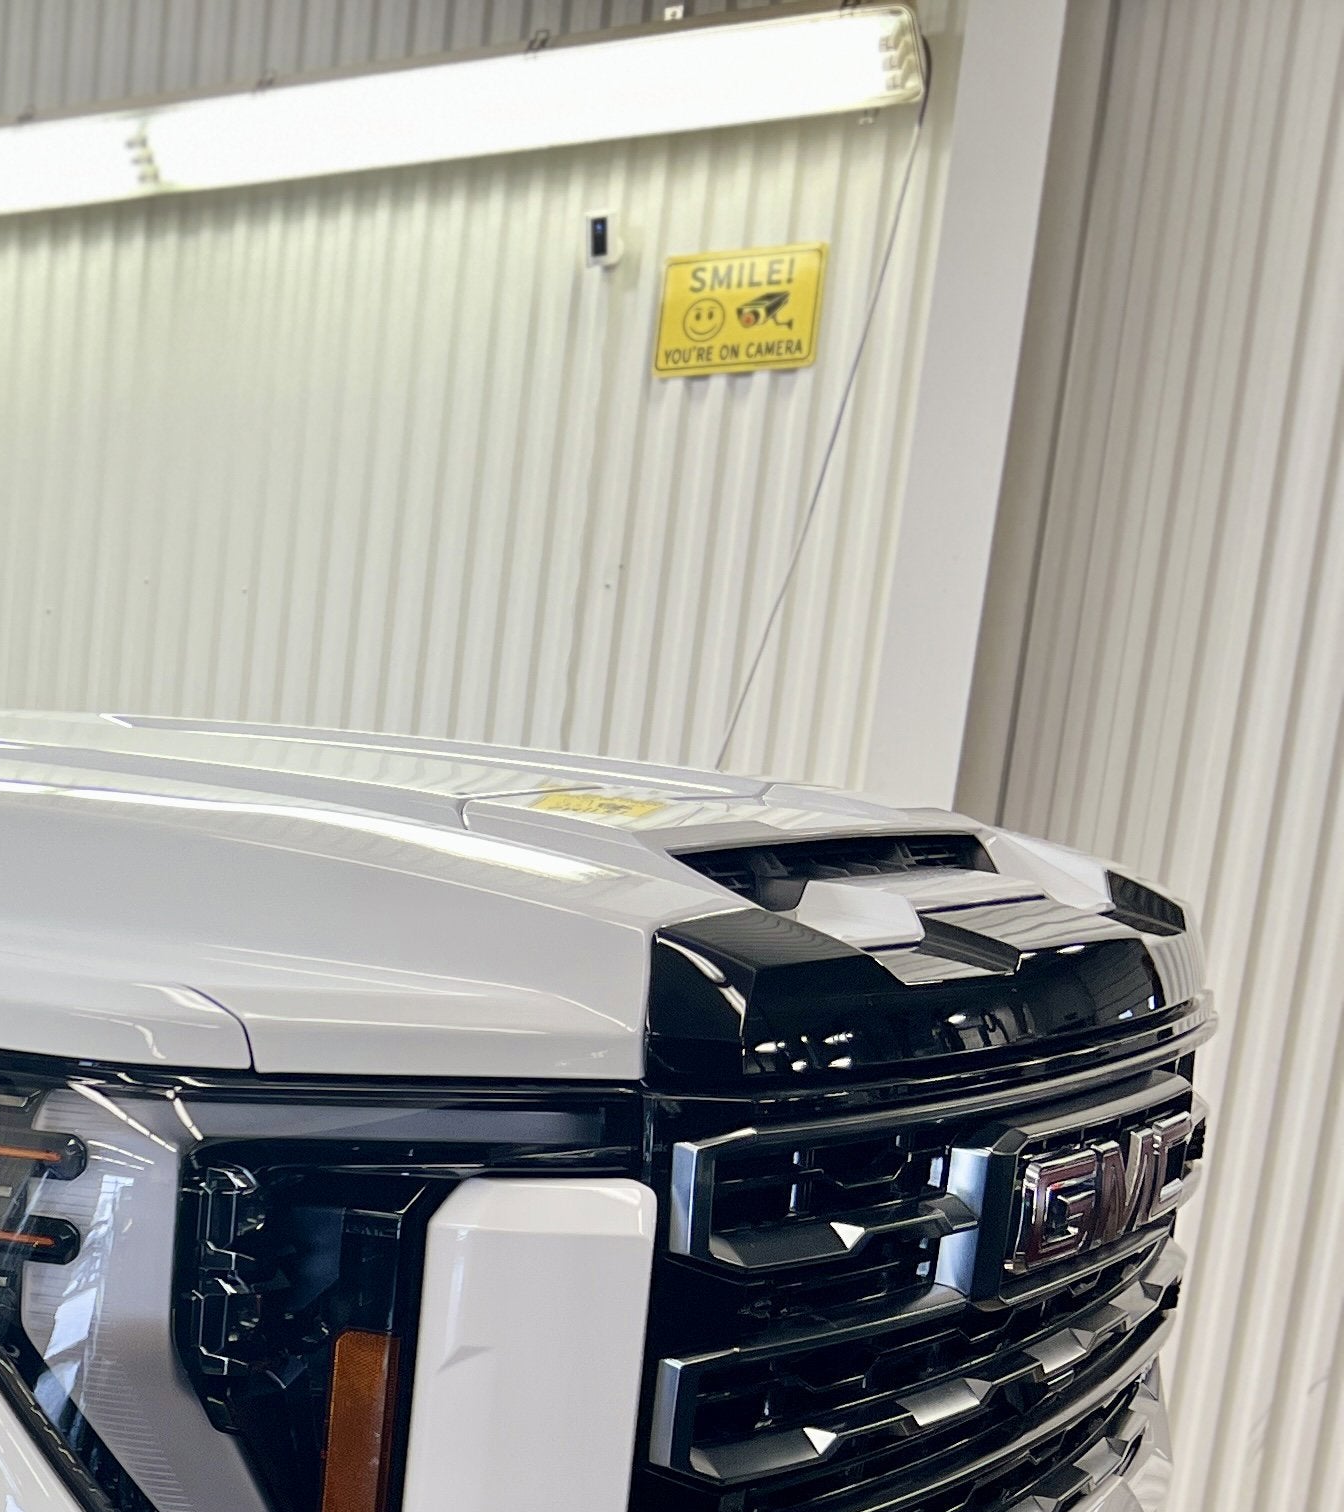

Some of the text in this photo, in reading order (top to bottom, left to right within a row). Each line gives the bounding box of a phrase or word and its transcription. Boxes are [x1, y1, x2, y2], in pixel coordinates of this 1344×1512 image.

[689, 257, 795, 293] SMILE!
[664, 338, 803, 365] YOU'RE ON CAMERA
[1016, 1111, 1192, 1268] GMC
